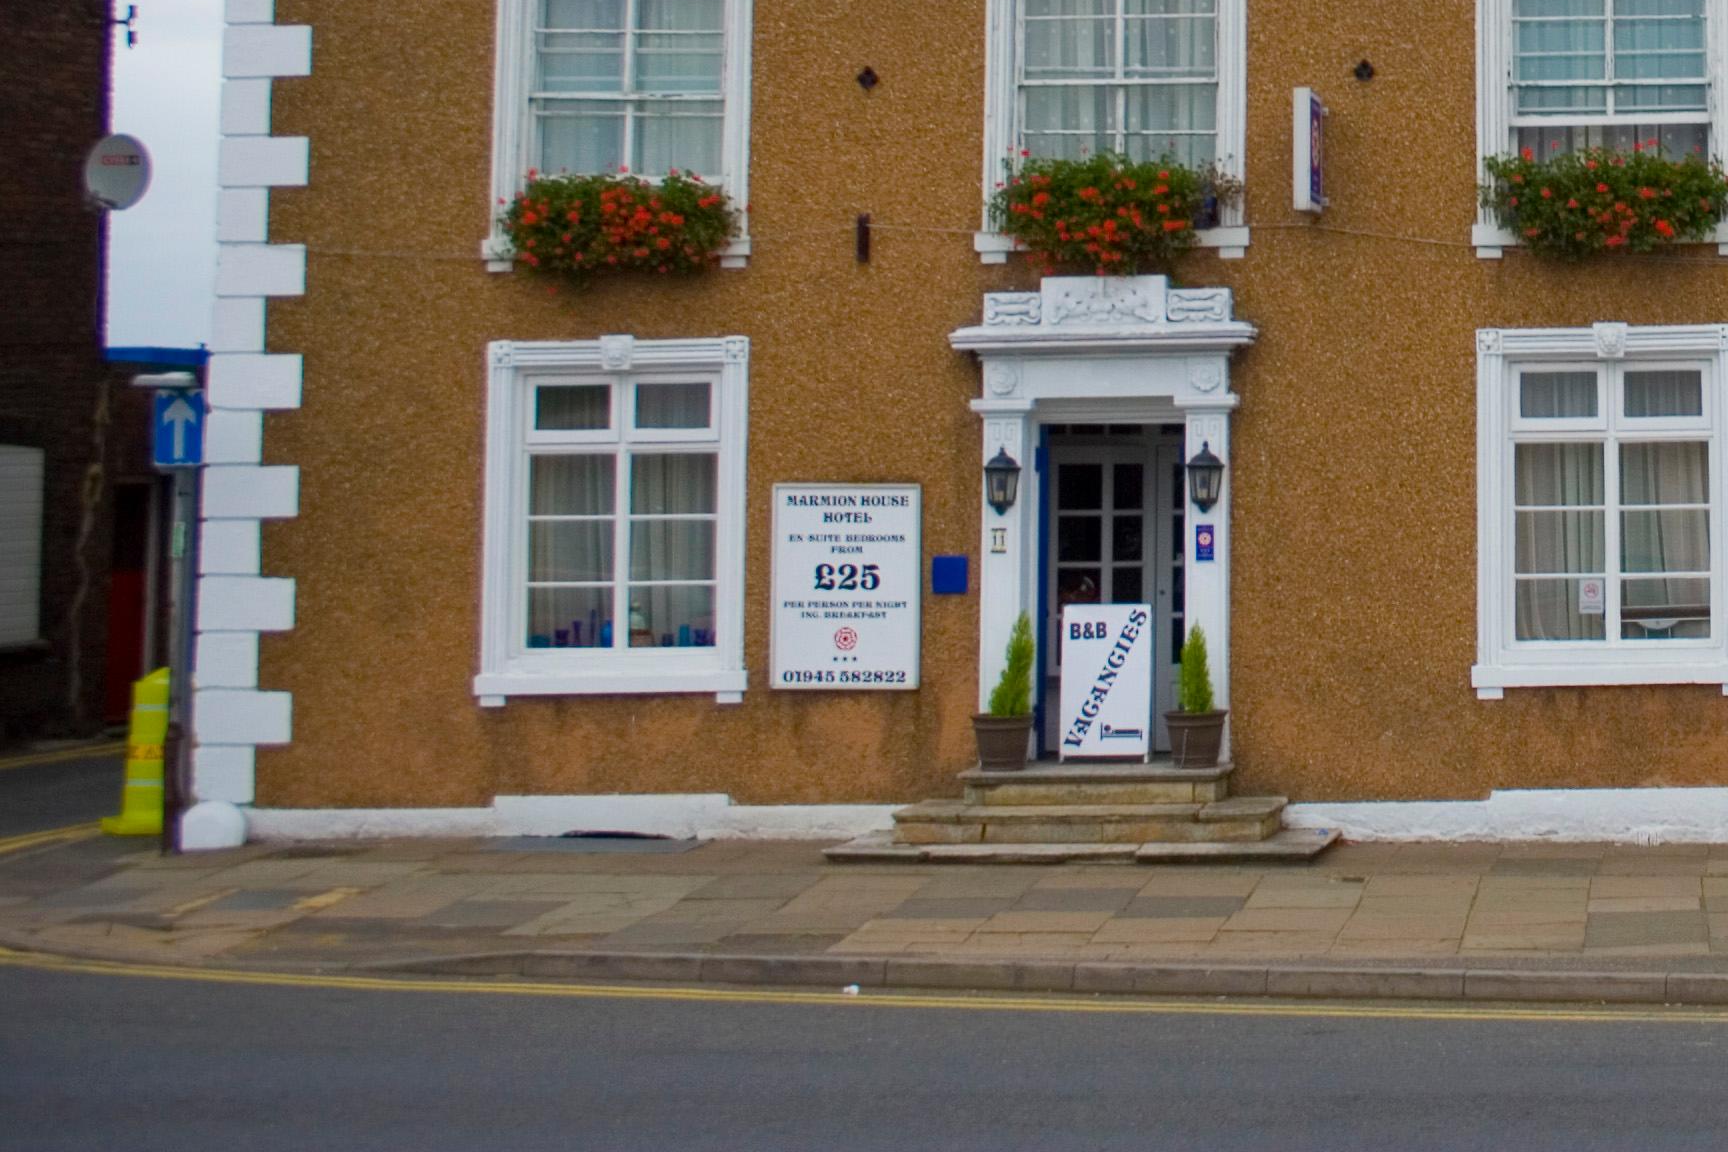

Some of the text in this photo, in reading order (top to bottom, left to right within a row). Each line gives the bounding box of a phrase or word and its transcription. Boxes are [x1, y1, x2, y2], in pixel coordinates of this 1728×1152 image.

[786, 495, 910, 507] MARMION HOUSE
[823, 511, 873, 524] HOTEL
[807, 533, 842, 543] SUITE
[845, 533, 906, 543] BEDROOMS
[830, 545, 864, 554] FROM
[814, 563, 881, 591] £25
[783, 600, 805, 609] PER
[807, 600, 849, 609] PERSON
[851, 600, 873, 609] PER
[1069, 621, 1108, 641] B&B
[783, 669, 907, 684] 01945 582822
